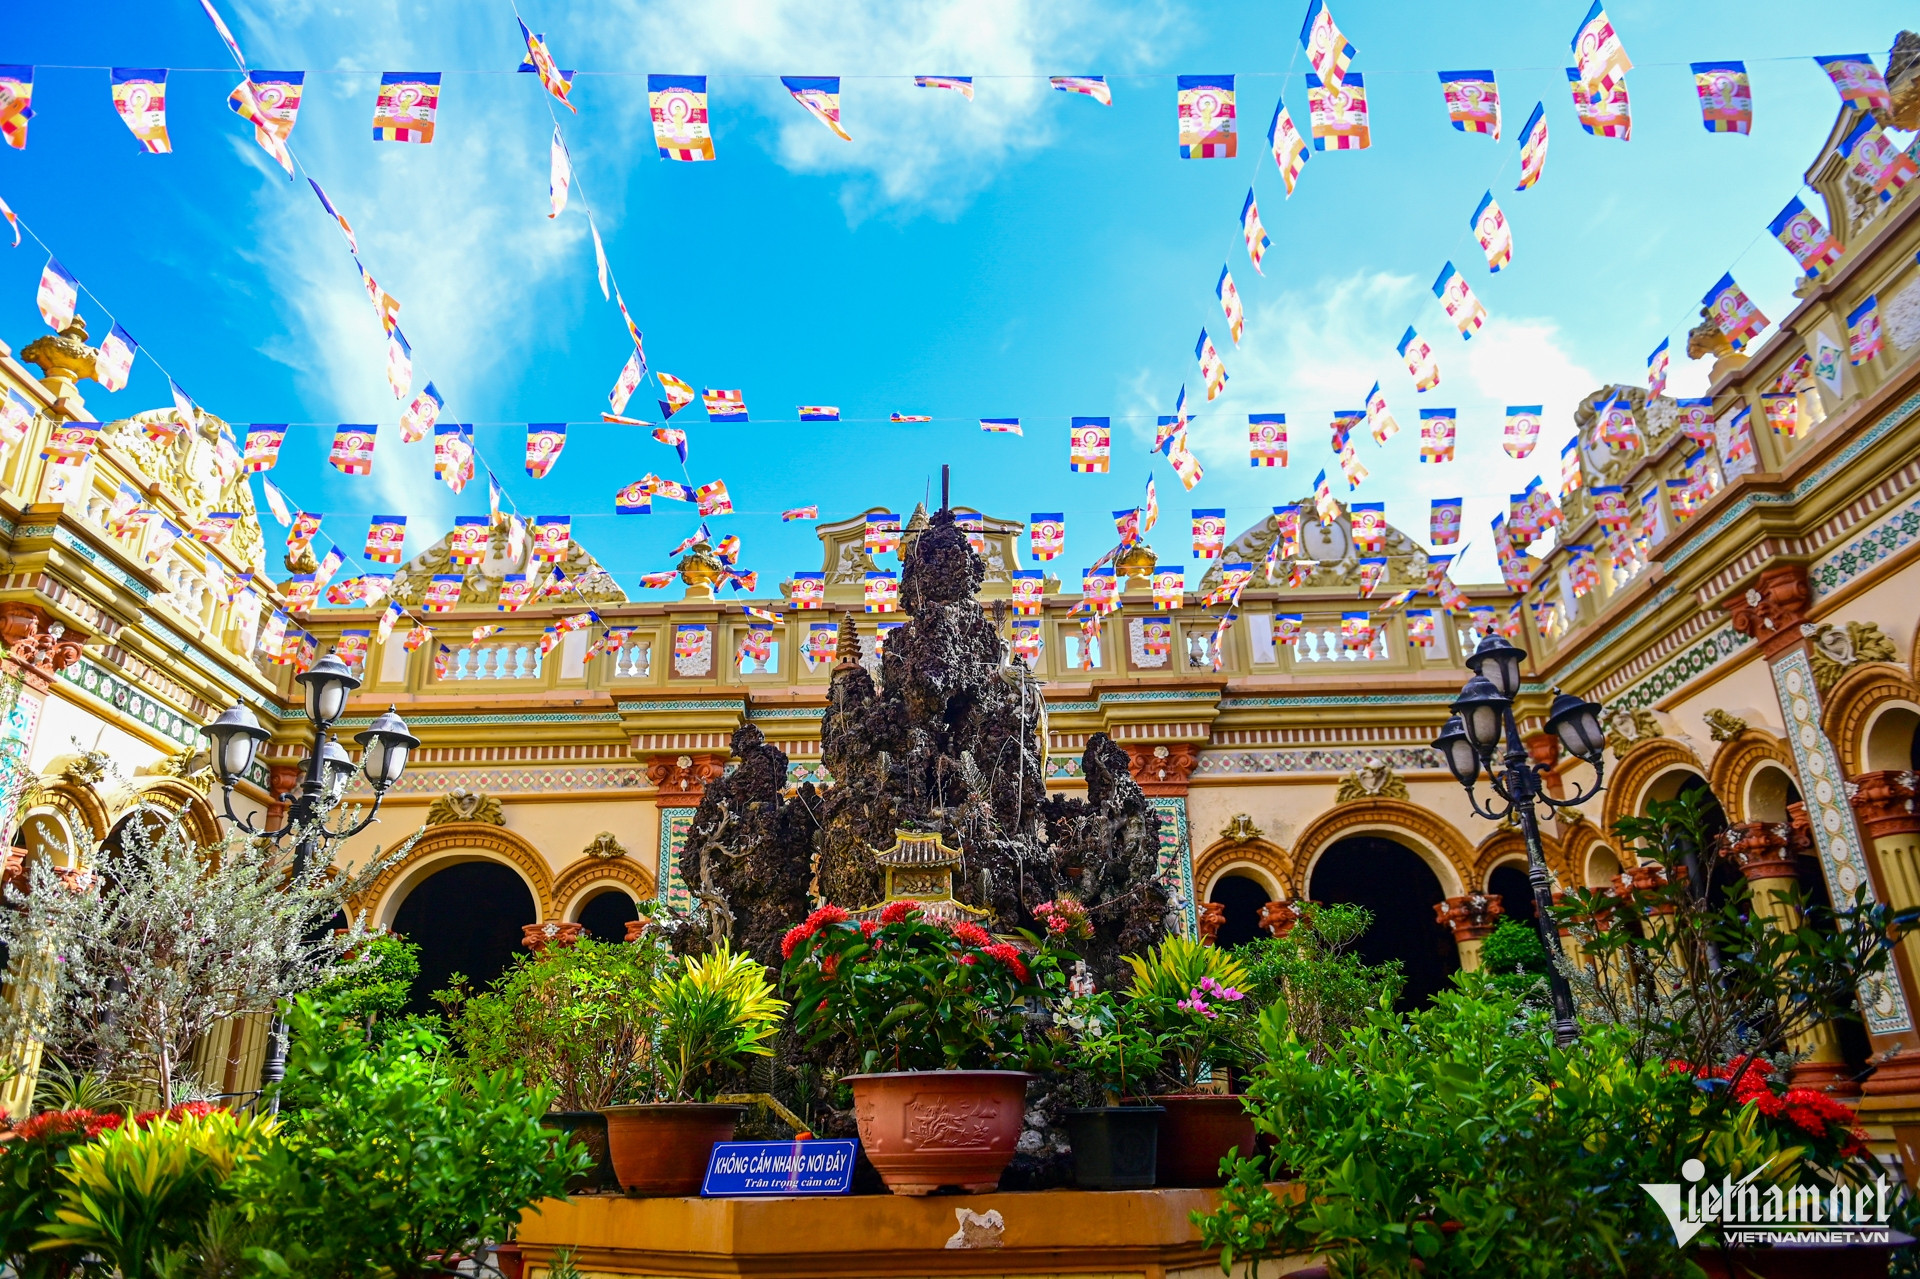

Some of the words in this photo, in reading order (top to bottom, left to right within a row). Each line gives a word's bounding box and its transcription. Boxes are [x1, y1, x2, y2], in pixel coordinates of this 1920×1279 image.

[714, 1152, 748, 1174] KHÔNG
[772, 1155, 805, 1173] NHANG
[806, 1153, 826, 1172] NƠI
[825, 1150, 847, 1172] ĐÂY
[745, 1178, 769, 1188] Trân
[771, 1178, 799, 1189] trọng
[801, 1176, 823, 1187] cảm
[824, 1177, 842, 1187] ơn!
